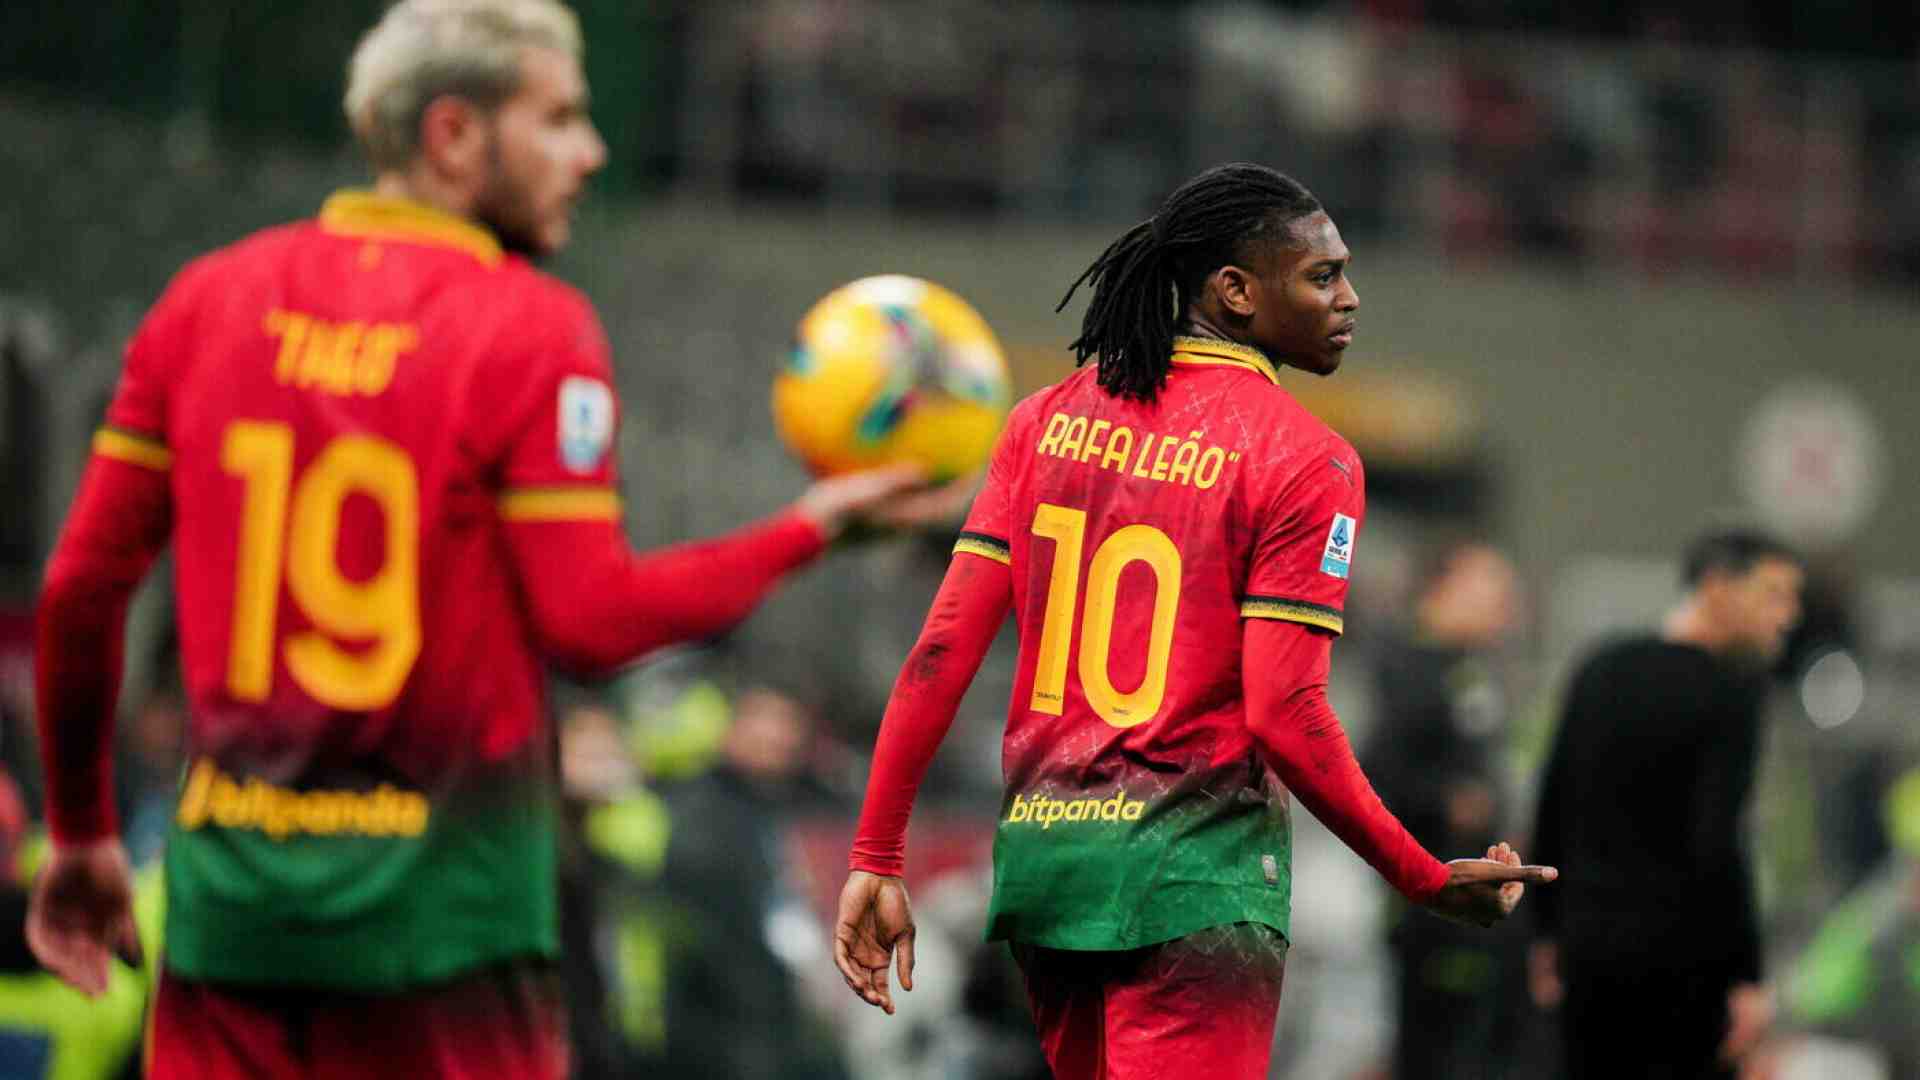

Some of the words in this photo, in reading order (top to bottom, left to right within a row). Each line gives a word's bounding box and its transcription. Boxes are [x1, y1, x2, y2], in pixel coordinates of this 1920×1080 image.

[1037, 412, 1134, 473] RAFA
[221, 420, 423, 711] 19
[1031, 503, 1182, 728] 10
[1009, 790, 1145, 829] bitpanda
